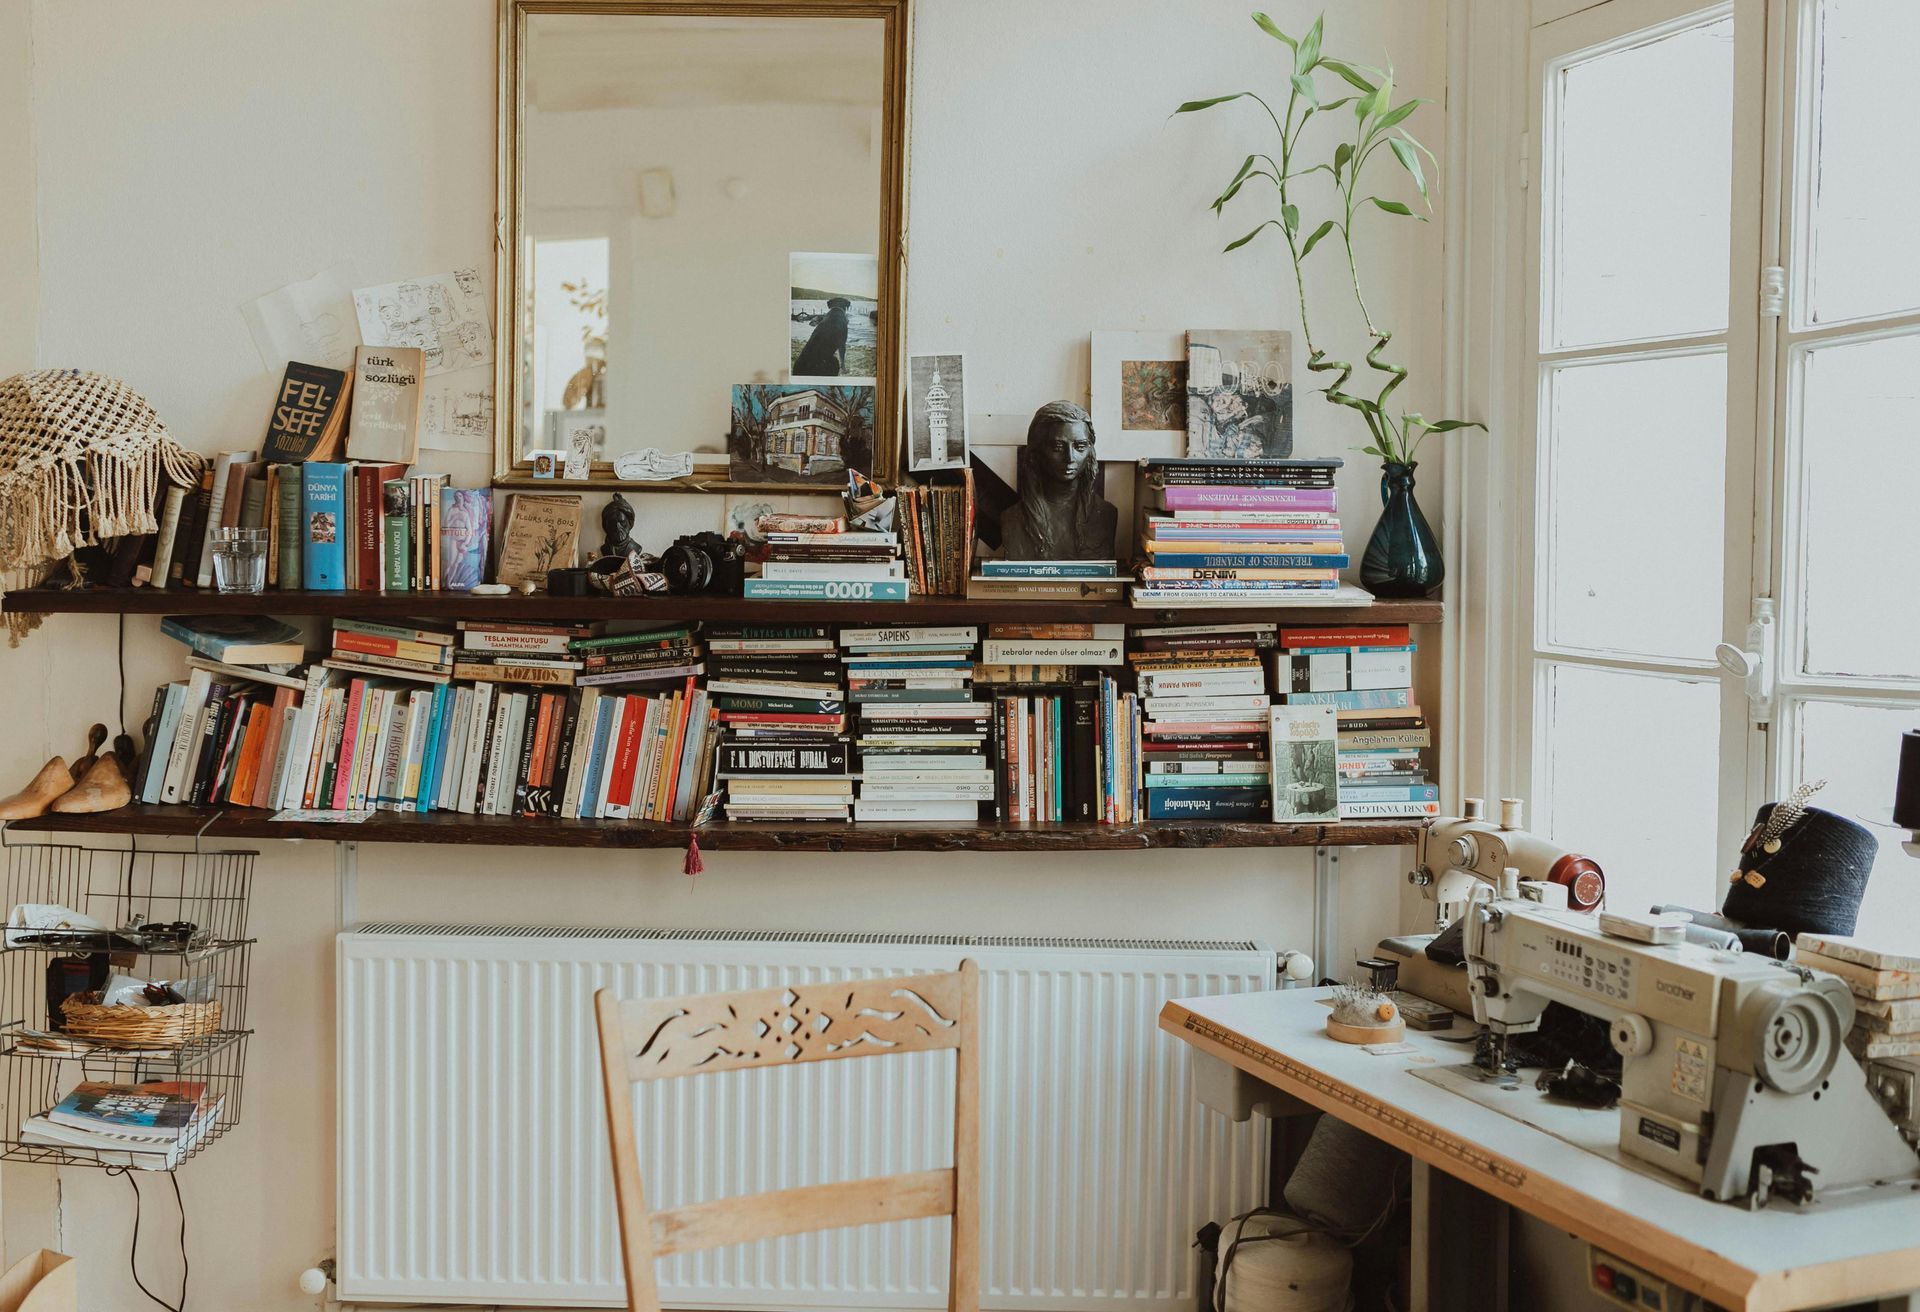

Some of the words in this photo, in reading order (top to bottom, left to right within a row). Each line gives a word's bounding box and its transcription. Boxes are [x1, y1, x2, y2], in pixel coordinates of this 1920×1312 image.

[281, 379, 332, 411] FEL-
[273, 405, 325, 437] SEFE
[1204, 556, 1246, 566] ISTANBUL
[1248, 556, 1260, 566] OF
[1262, 556, 1313, 567] TREASURES
[1192, 570, 1237, 579] DENIM
[825, 582, 874, 599] 1000
[483, 635, 519, 643] TESLA'NIN
[520, 636, 549, 645] KUTUSU
[877, 630, 910, 642] SAPIENS
[1001, 648, 1033, 656] zebralar
[1035, 648, 1058, 656] neden
[1060, 648, 1078, 656] ülser
[1080, 647, 1107, 656] olmaz?
[503, 666, 559, 681] KOZMOS
[1181, 681, 1202, 689] ORHAN
[731, 699, 763, 709] MOMO
[625, 720, 637, 747] Sofie'nin
[495, 735, 503, 751] BÖYLE
[385, 736, 402, 779] HİSSETMEK
[491, 752, 500, 775] BUYURDU
[559, 754, 568, 770] Smith
[730, 750, 737, 769] F.
[738, 750, 747, 769] M.
[748, 749, 796, 769] DOSTOYEVSKİ
[799, 750, 828, 769] BUDALA
[520, 752, 531, 779] Hayatlar
[1338, 762, 1367, 771] ORNBY
[1164, 797, 1211, 811] FerhAntoloji
[1349, 804, 1398, 814] YANILGISI
[1403, 804, 1434, 813] TANRI
[1655, 978, 1696, 1001] brother
